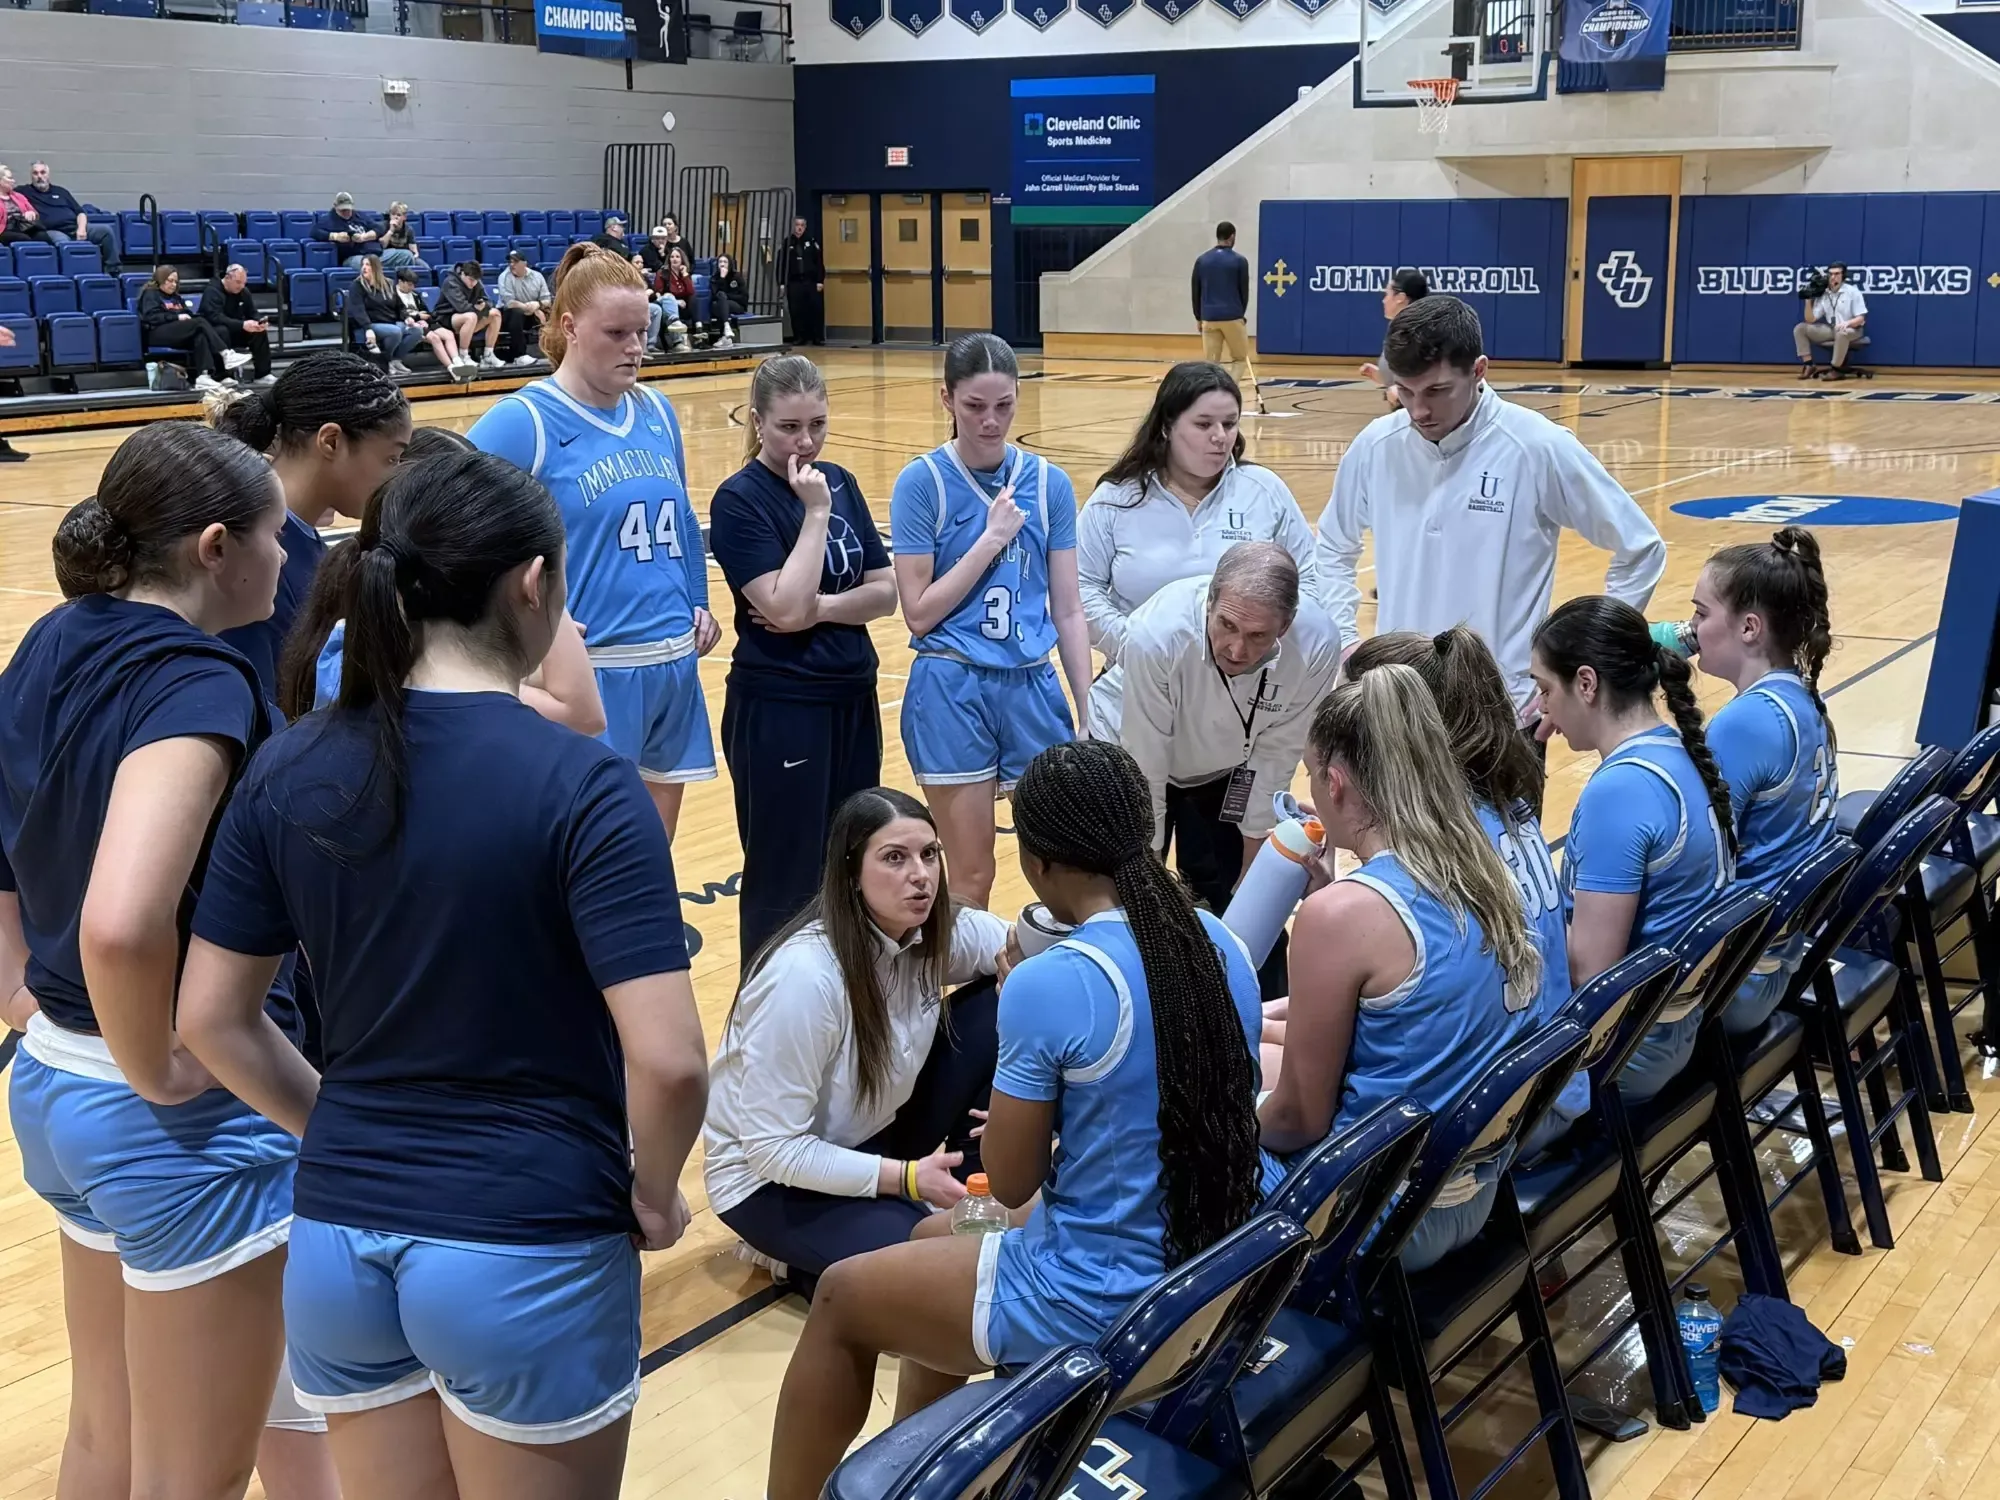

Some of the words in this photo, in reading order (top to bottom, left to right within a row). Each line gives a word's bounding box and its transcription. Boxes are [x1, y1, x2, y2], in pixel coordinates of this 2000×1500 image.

[543, 5, 624, 32] CHAMPIONS
[1582, 19, 1650, 33] CHAMPIONSHIP
[1046, 116, 1104, 131] Cleveland
[1107, 115, 1141, 130] Clinic
[1047, 136, 1073, 147] Sports
[1075, 135, 1112, 146] Medicine
[1041, 174, 1062, 182] Official
[1063, 174, 1086, 182] Medical
[1087, 173, 1111, 182] Provider
[1112, 173, 1120, 182] for
[1025, 183, 1040, 192] John
[1041, 183, 1063, 192] Carroll
[1064, 182, 1097, 193] University
[1098, 183, 1113, 192] Blue
[1115, 183, 1140, 192] Streaks
[1309, 266, 1393, 292] JOHN
[1396, 266, 1540, 294] ARROLL
[1697, 266, 1794, 295] BLUE
[1796, 265, 1972, 295] SREAKS
[618, 498, 684, 563] 44
[1680, 1321, 1720, 1334] POWER
